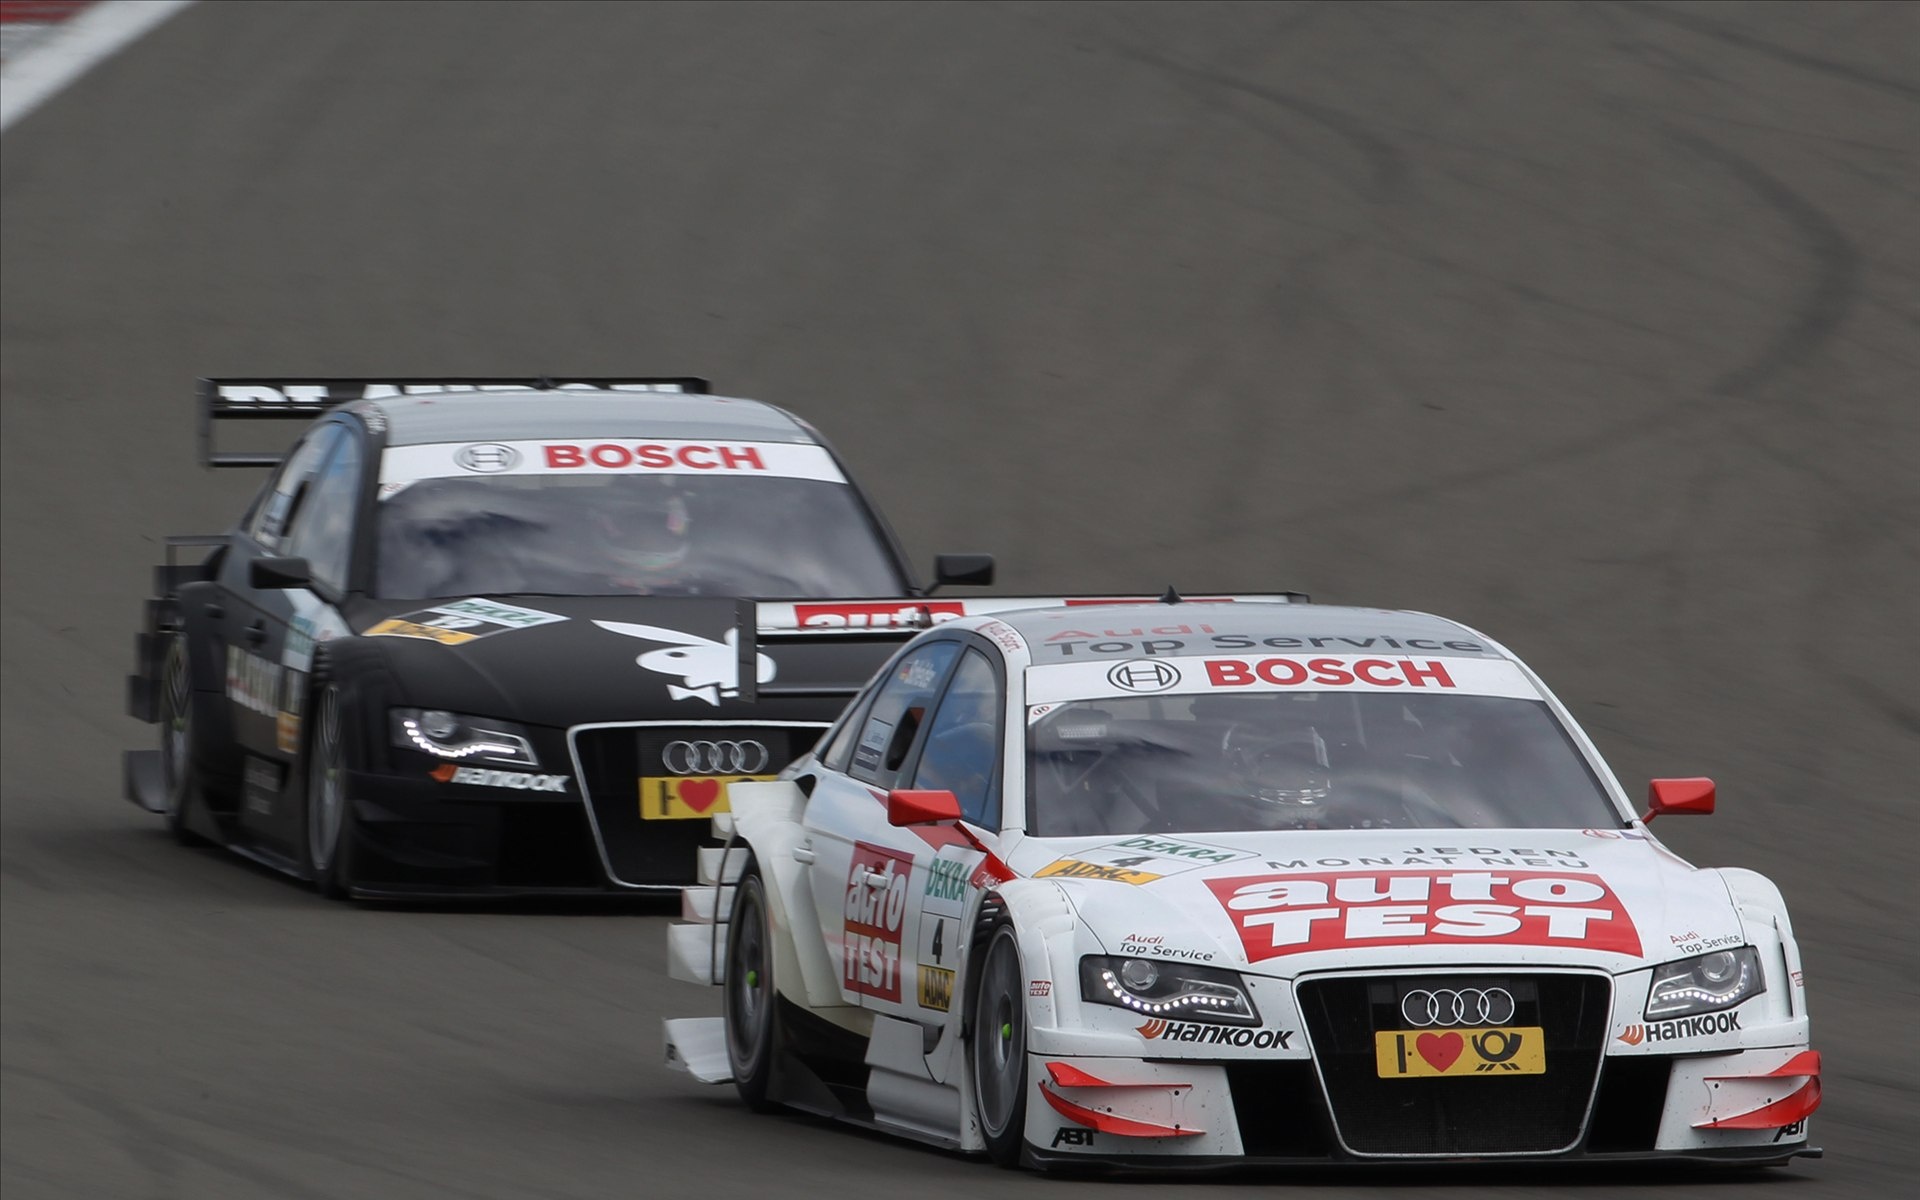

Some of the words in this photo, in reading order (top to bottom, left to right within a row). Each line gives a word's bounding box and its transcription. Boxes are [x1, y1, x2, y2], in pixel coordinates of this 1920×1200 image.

[542, 444, 766, 470] BOSCH
[1044, 624, 1214, 641] Audi
[1044, 639, 1185, 655] Top
[1213, 634, 1483, 653] Service
[1204, 658, 1456, 688] BOSCH
[1113, 838, 1236, 863] DEKRA
[1403, 847, 1578, 858] JEDEN
[1056, 861, 1140, 880] ADAC
[1109, 856, 1157, 867] 4
[1267, 857, 1459, 870] MONAT
[1491, 857, 1589, 869] NEU
[925, 856, 973, 902] DEKRA
[846, 858, 906, 932] auto
[1227, 872, 1605, 911] auto
[1243, 904, 1612, 948] TEST
[932, 919, 944, 964] 4
[1123, 934, 1164, 944] Audi
[1670, 931, 1699, 944] Audi
[1676, 944, 1702, 955] Top
[1704, 934, 1742, 949] Service
[845, 931, 899, 990] TEST
[1120, 942, 1147, 955] Top
[1151, 945, 1213, 961] Service
[923, 968, 954, 1009] ADAC
[1030, 982, 1050, 990] auto
[1051, 1127, 1099, 1147] ABT
